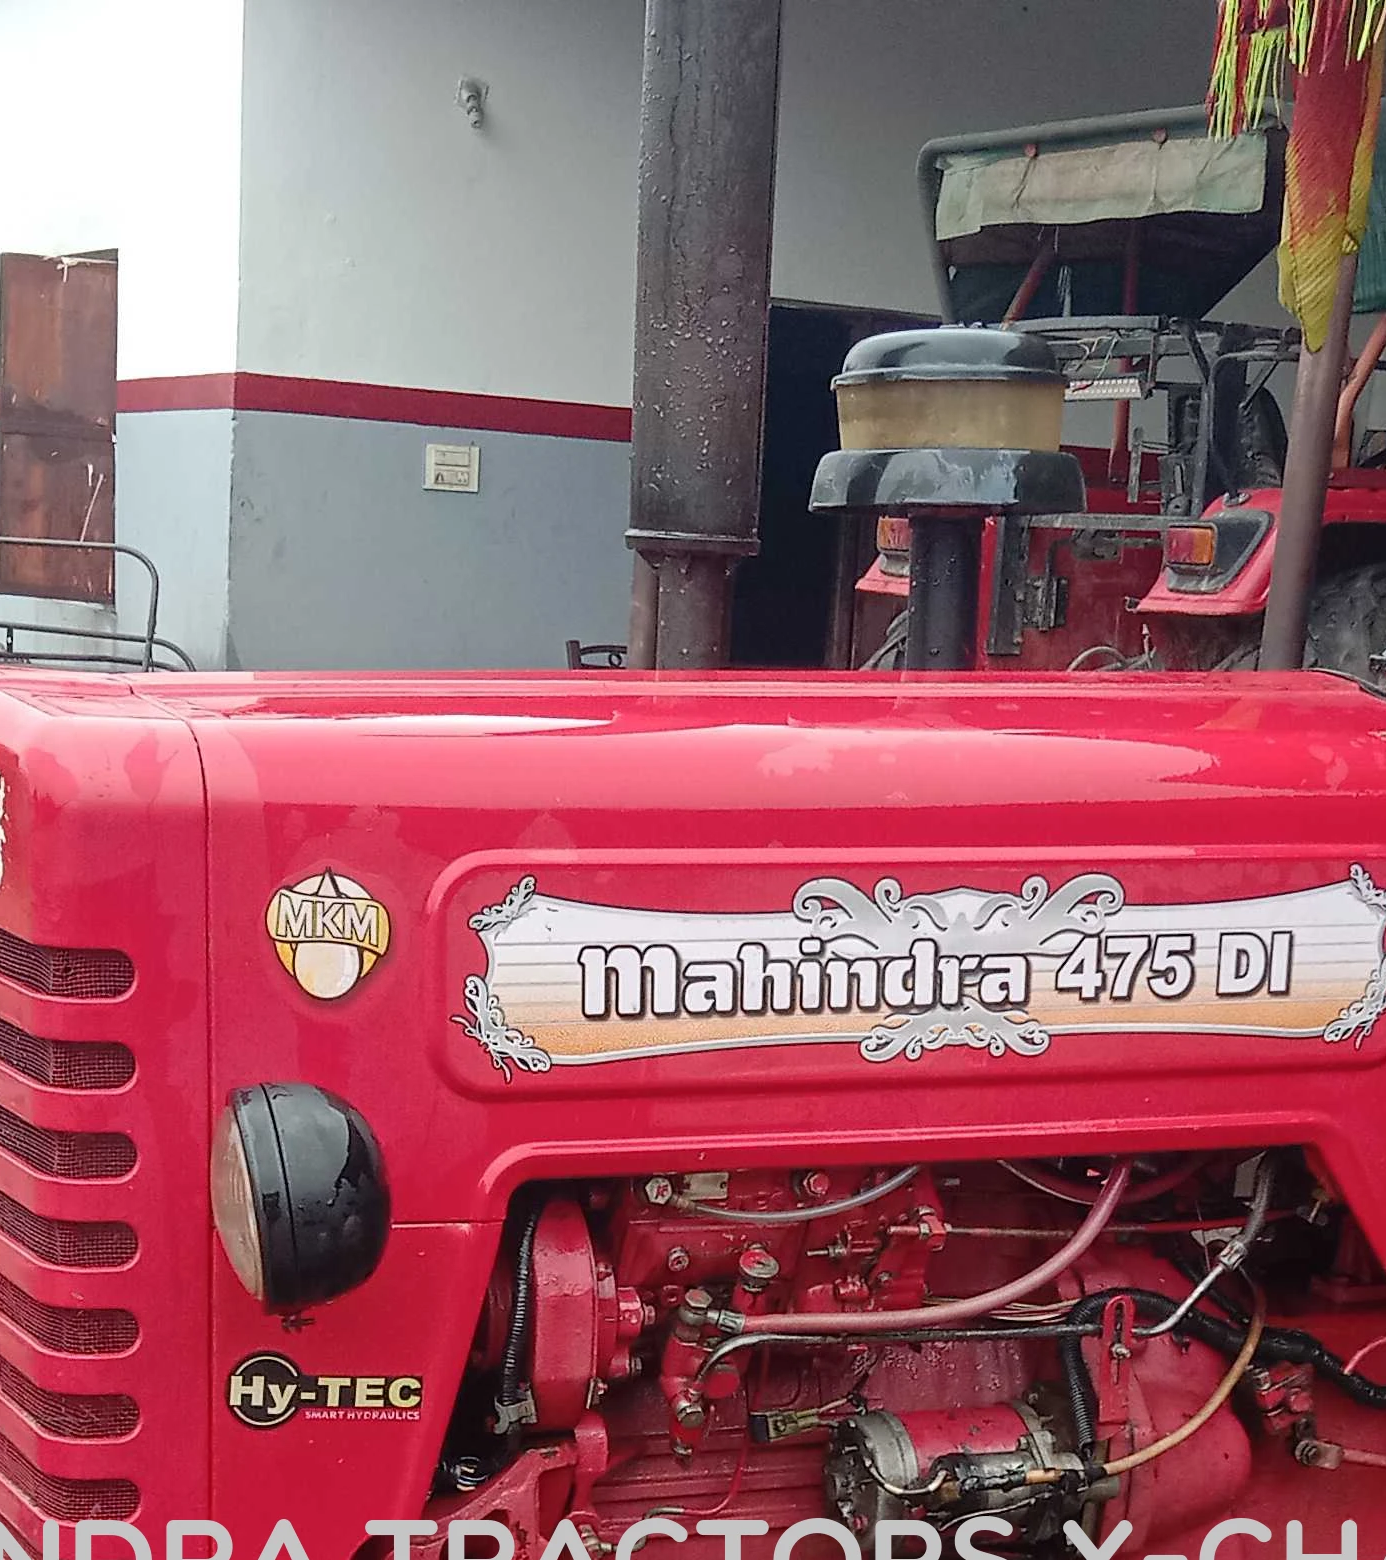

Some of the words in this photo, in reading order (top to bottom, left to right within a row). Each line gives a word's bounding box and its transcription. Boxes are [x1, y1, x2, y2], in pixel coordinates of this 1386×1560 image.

[275, 892, 380, 948] MKM
[578, 938, 1032, 1020] Mahindra
[1055, 934, 1196, 1002] 475
[1215, 930, 1294, 997] DI
[229, 1375, 422, 1415] Hy-TEC
[305, 1410, 343, 1420] SMART
[347, 1410, 420, 1421] HYDRAULICS
